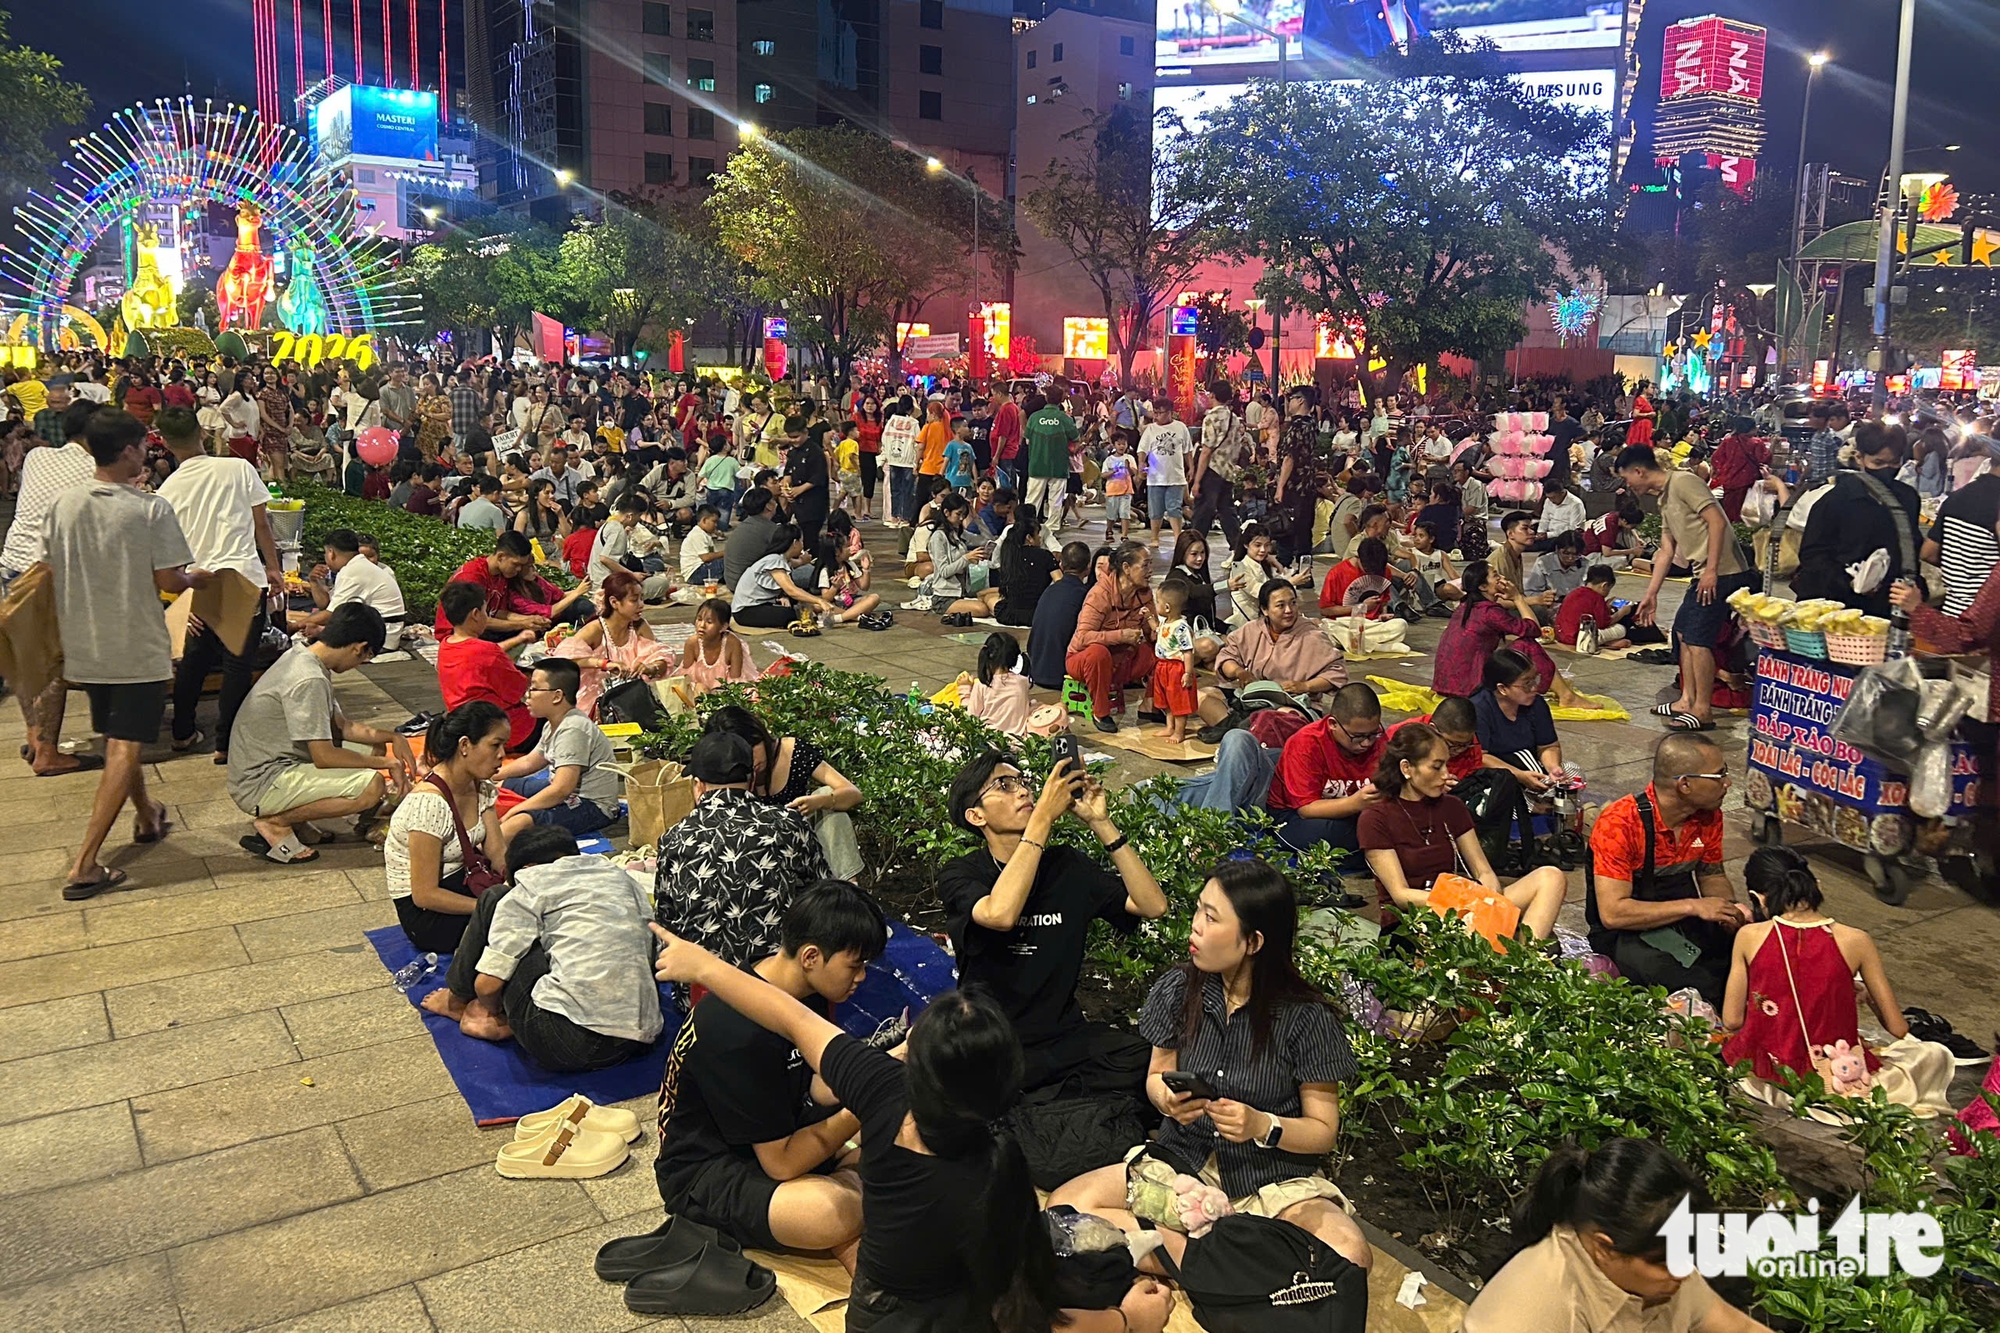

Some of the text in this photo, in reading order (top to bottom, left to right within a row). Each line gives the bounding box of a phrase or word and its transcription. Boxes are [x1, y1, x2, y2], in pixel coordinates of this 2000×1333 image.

[1523, 82, 1603, 99] AMSUNG
[376, 113, 416, 125] MASTERI
[271, 332, 372, 371] 2026
[494, 431, 518, 443] YAOURT
[1039, 417, 1060, 426] Grab
[1757, 654, 1790, 683] BÁNH
[1790, 664, 1830, 694] TRÁNG
[1760, 682, 1791, 713] BÁNH
[1792, 693, 1833, 725] TRÁNG
[1756, 711, 1791, 740] BẮP
[1792, 727, 1834, 755] XÀO
[1811, 759, 1838, 790] CÓC
[1838, 764, 1866, 799] LẮC
